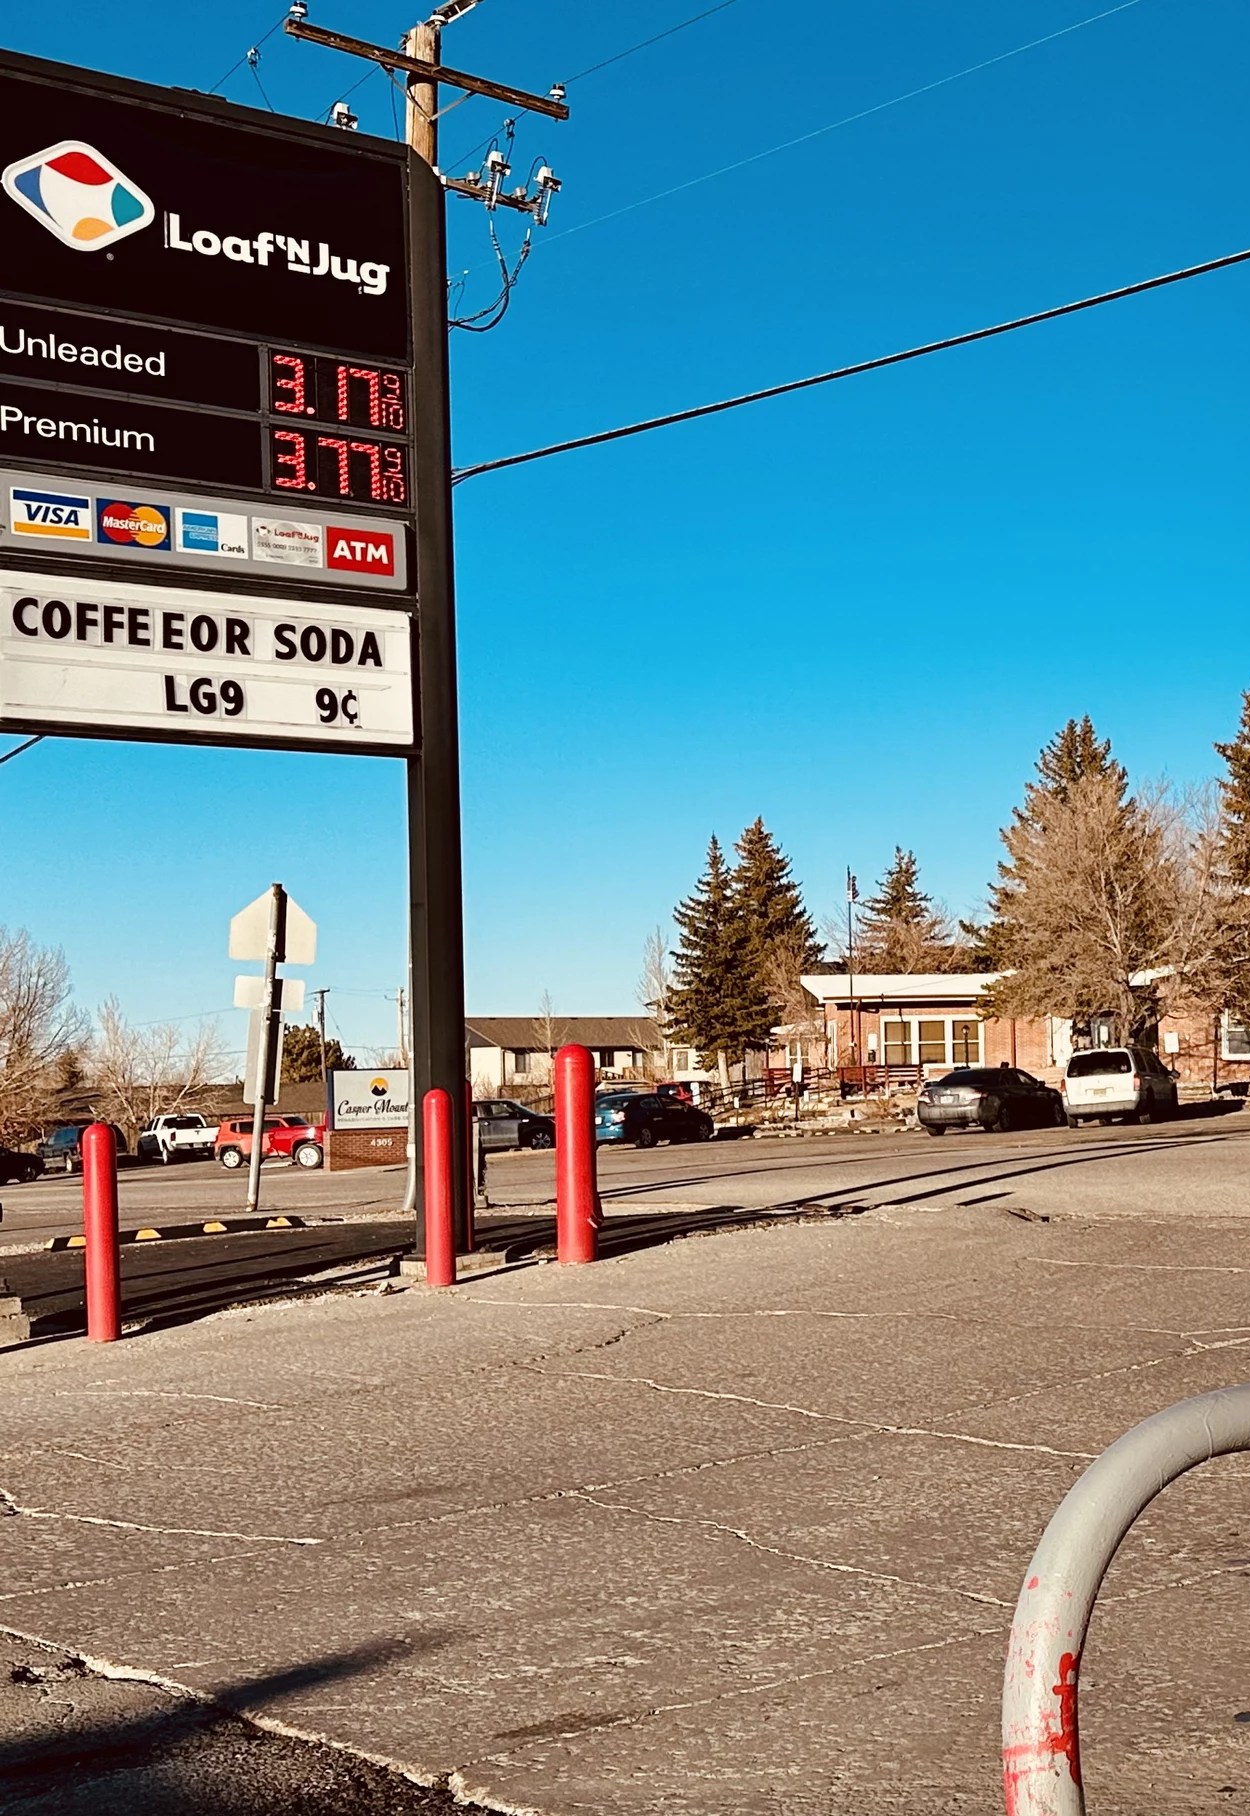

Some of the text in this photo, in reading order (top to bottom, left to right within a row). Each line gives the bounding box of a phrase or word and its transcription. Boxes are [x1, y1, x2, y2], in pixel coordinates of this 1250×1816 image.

[0, 325, 166, 377] Unleaded
[274, 355, 379, 426] 3.17
[1, 405, 155, 452] Premium
[274, 430, 380, 500] 3.77
[24, 503, 80, 526] VISA
[102, 515, 166, 534] MasterCard
[221, 543, 245, 554] Cards
[333, 539, 389, 565] ATM
[273, 622, 383, 668] SODA
[164, 674, 359, 724] LG9 9¢
[337, 1099, 372, 1116] Casper
